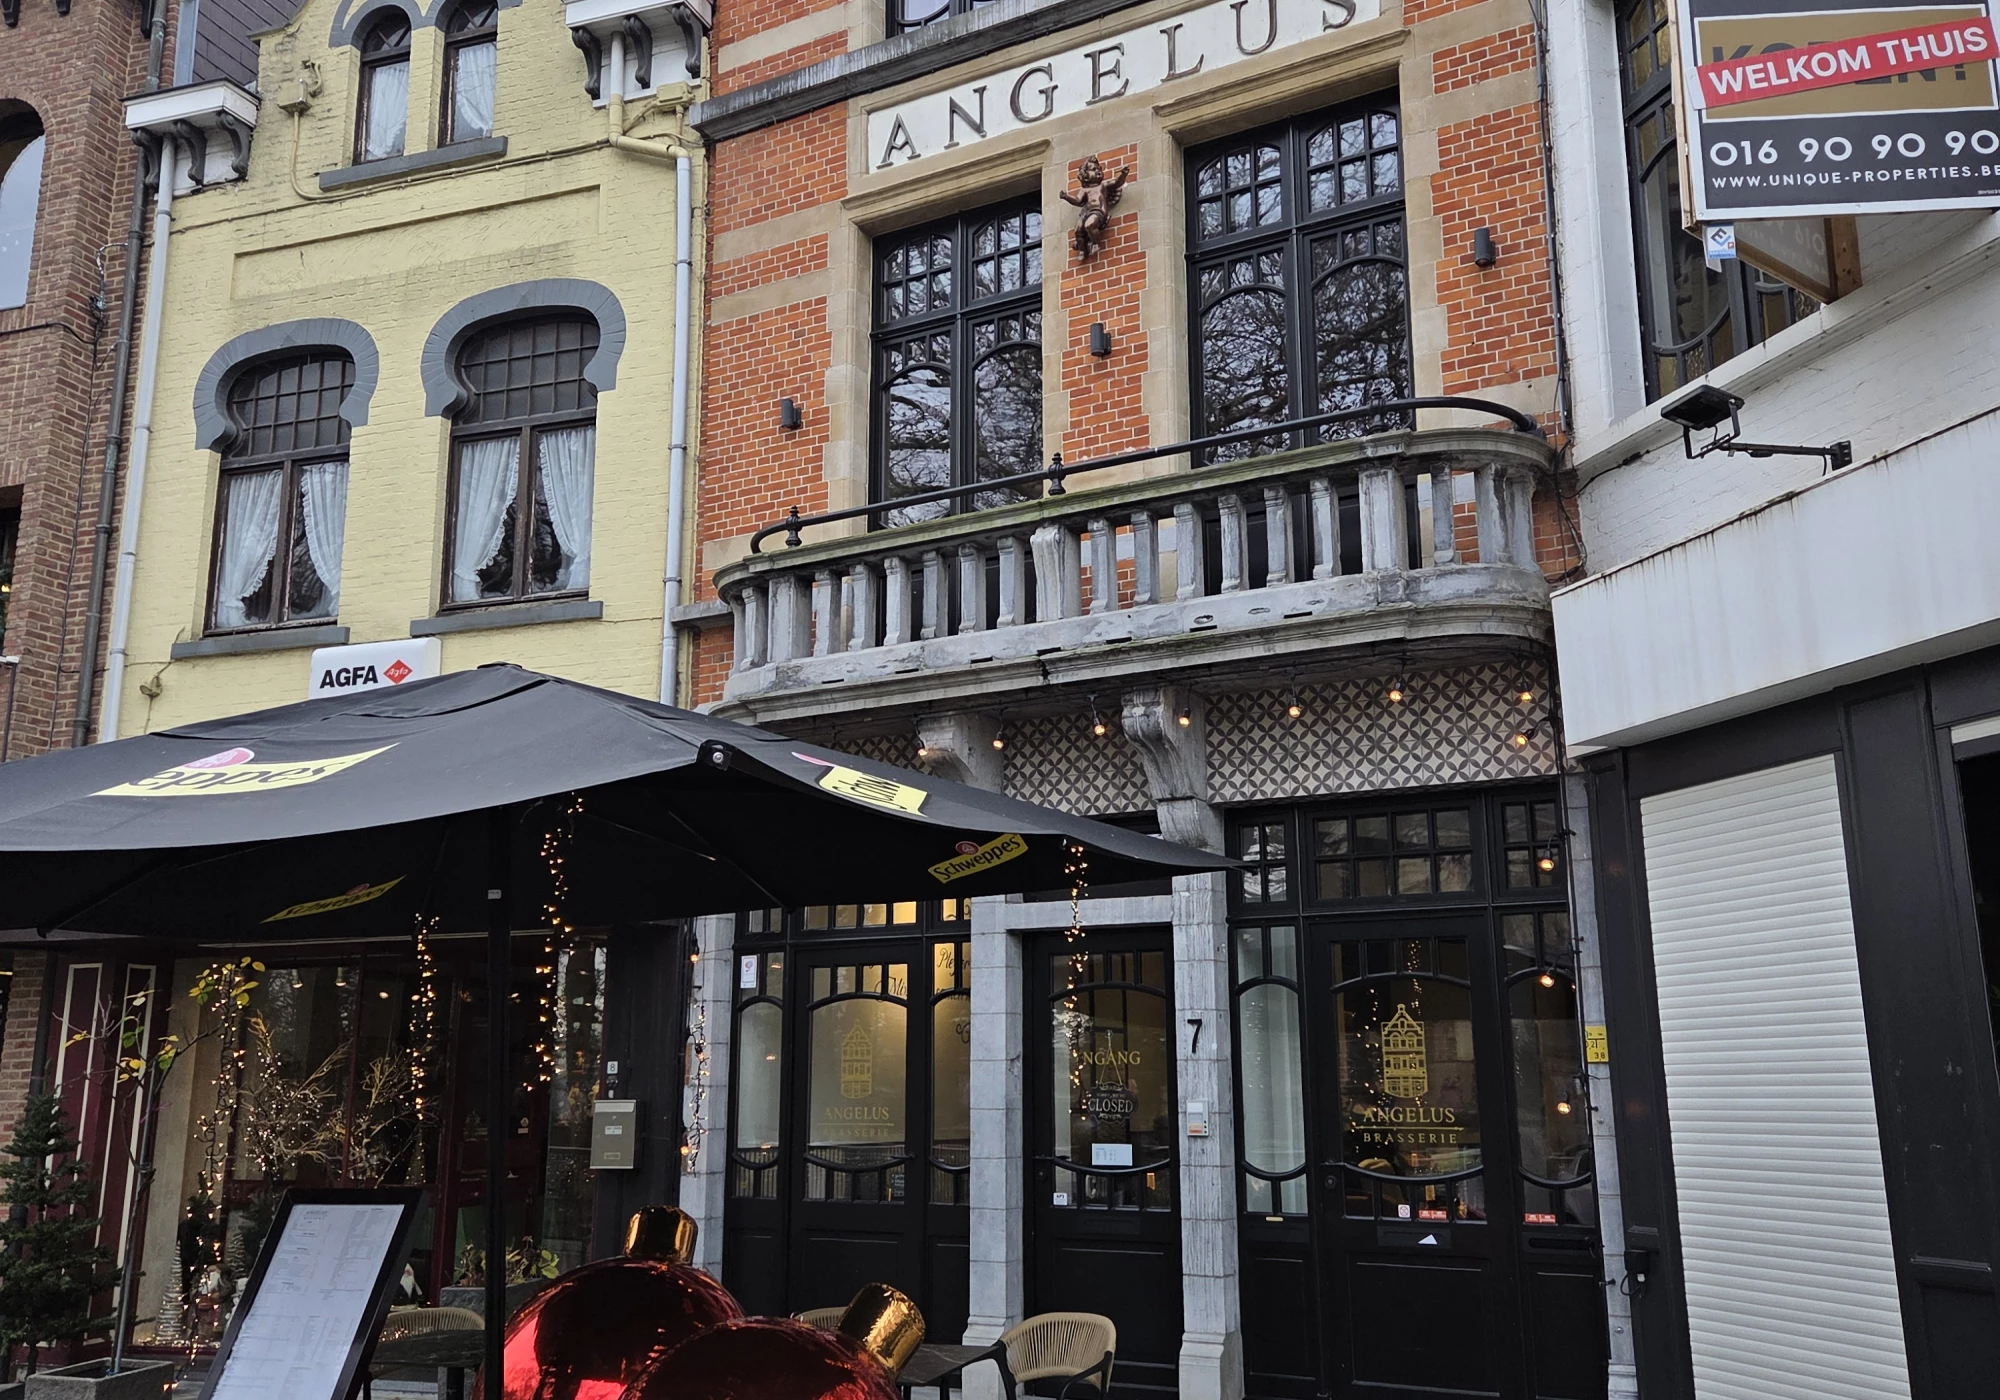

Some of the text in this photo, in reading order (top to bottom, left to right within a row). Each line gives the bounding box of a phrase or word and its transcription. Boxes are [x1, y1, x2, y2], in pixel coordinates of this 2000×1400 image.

[1709, 45, 1872, 95] WELKOM
[1877, 26, 1988, 67] THUIS
[1710, 129, 2000, 166] 016 90 90 90
[1712, 165, 2000, 187] WWW.UNIQUE-PROPERTIES.BE
[319, 664, 379, 689] AGFA
[933, 836, 1021, 880] Schweppes
[1187, 1019, 1203, 1054] 7
[609, 1063, 617, 1072] 8
[824, 1106, 890, 1121] ANGELUS
[1089, 1099, 1134, 1113] CLOSED
[1363, 1107, 1456, 1123] ANGELUS
[1363, 1133, 1457, 1144] BRASSERIE
